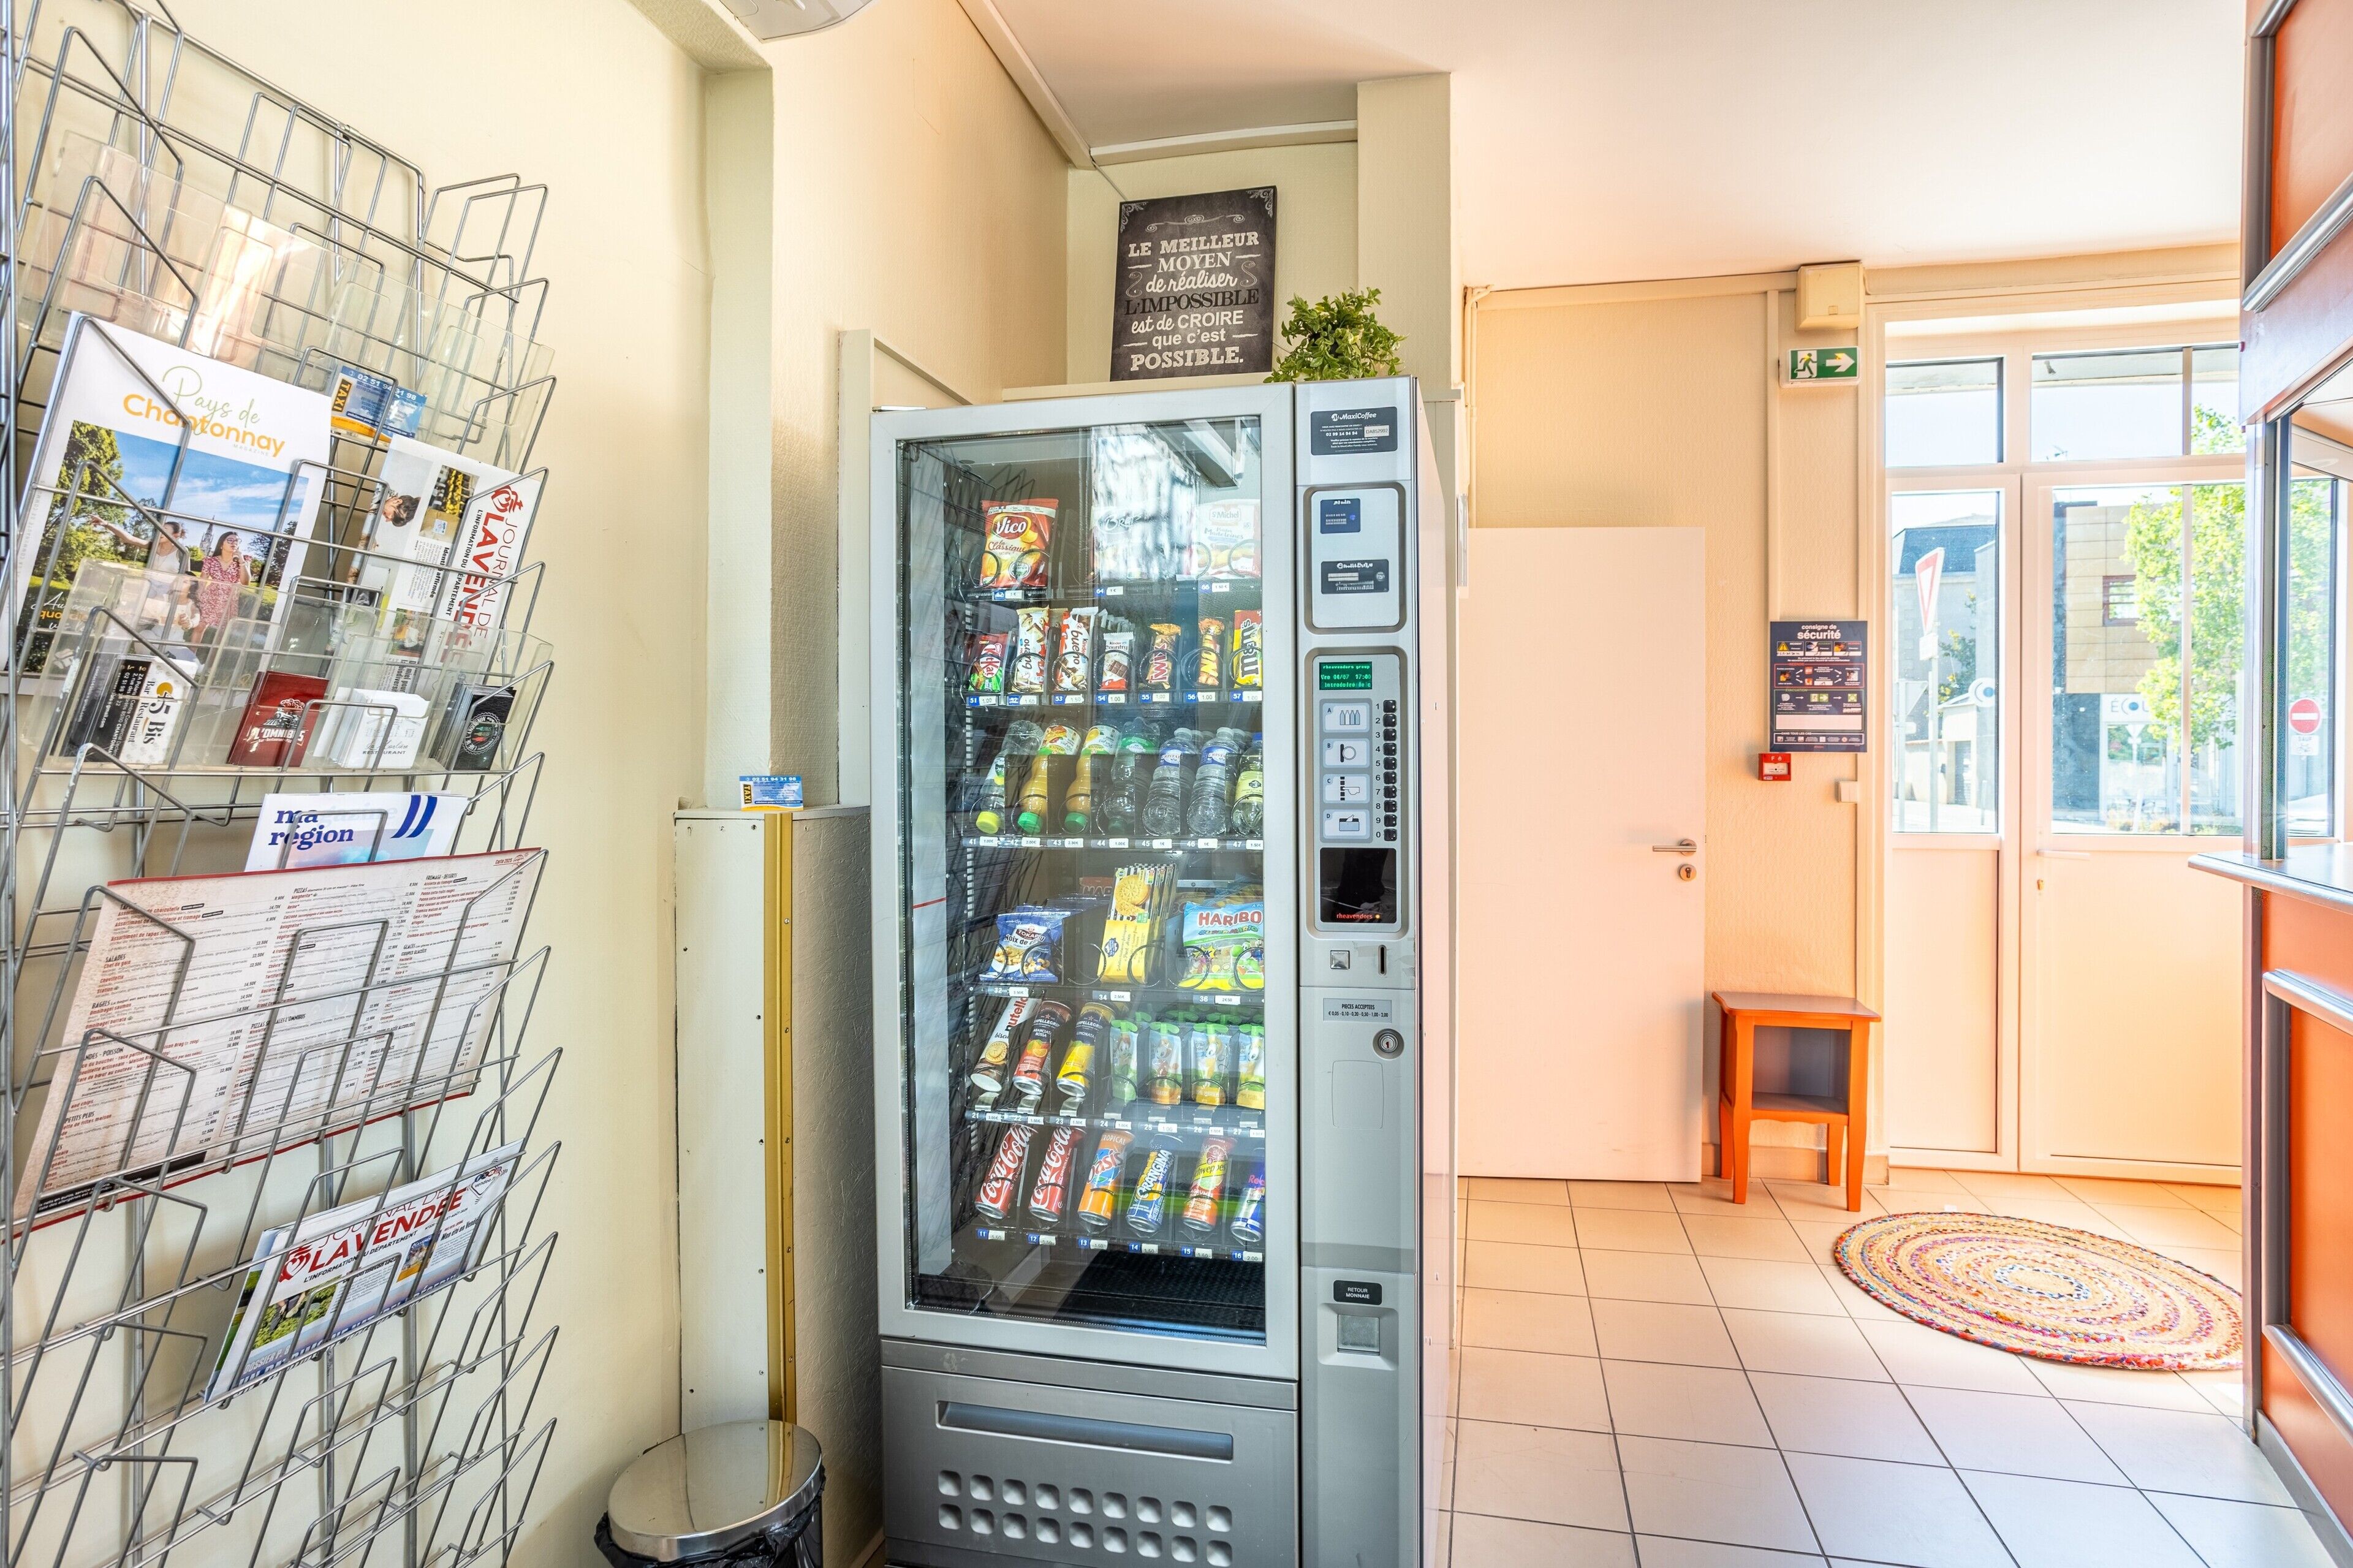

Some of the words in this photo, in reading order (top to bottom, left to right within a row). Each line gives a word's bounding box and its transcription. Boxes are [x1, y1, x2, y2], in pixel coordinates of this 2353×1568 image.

[1128, 242, 1151, 257] LE
[1159, 231, 1259, 254] MEILLEUR
[1157, 251, 1232, 273] MOYEN
[1145, 275, 1166, 293] de
[1167, 270, 1238, 292] réaliser
[1124, 289, 1259, 315] L'IMPOSSIBLE
[1131, 316, 1155, 333] est
[1156, 314, 1175, 331] de
[1178, 309, 1243, 328] CROIRE
[1152, 333, 1182, 349] que
[1186, 330, 1226, 344] c'est
[1130, 346, 1244, 371] POSSIBLE.
[357, 373, 368, 382] 02
[162, 366, 233, 436] Pays
[238, 398, 260, 428] de
[333, 384, 350, 411] TAXI
[123, 393, 285, 458] Chantonnay
[1339, 412, 1377, 420] MaxiCoffee
[233, 444, 269, 456] MAGAZINE
[1218, 510, 1240, 519] Michel
[464, 509, 483, 558] L'INFORMATION
[996, 517, 1027, 534] Vico
[988, 541, 1026, 552] Classique
[461, 558, 469, 568] DU
[481, 518, 518, 607] JOURNAL
[430, 572, 441, 598] affirmée
[446, 568, 464, 616] ÉPARTEMENT
[474, 613, 491, 638] DE
[1797, 629, 1841, 640] sécurité
[1070, 630, 1083, 665] bueno
[403, 668, 412, 680] miel
[132, 680, 141, 695] Polaris
[143, 680, 156, 695] Bar
[400, 680, 408, 692] pour
[118, 714, 131, 741] Commercial
[128, 702, 150, 743] Restaurant
[107, 723, 122, 756] CHANTONNA
[143, 721, 166, 744] Bis
[251, 727, 306, 742] L'OMNIBS
[274, 809, 319, 824] ma
[268, 824, 354, 851] région
[1198, 911, 1262, 926] HARIBO
[1004, 934, 1018, 942] Noix
[1230, 925, 1259, 934] MARIO
[105, 953, 127, 963] SALADES
[91, 1000, 111, 1009] BAGELS
[102, 1047, 124, 1056] POISSON
[65, 1113, 83, 1124] PETITS
[1101, 1134, 1127, 1145] TROPICAL
[1136, 1149, 1172, 1199] ORANGINA
[303, 1256, 359, 1283] L'INFORMATION
[369, 1230, 418, 1255] DÉPARTEMENT
[245, 1352, 276, 1372] DOSSIER
